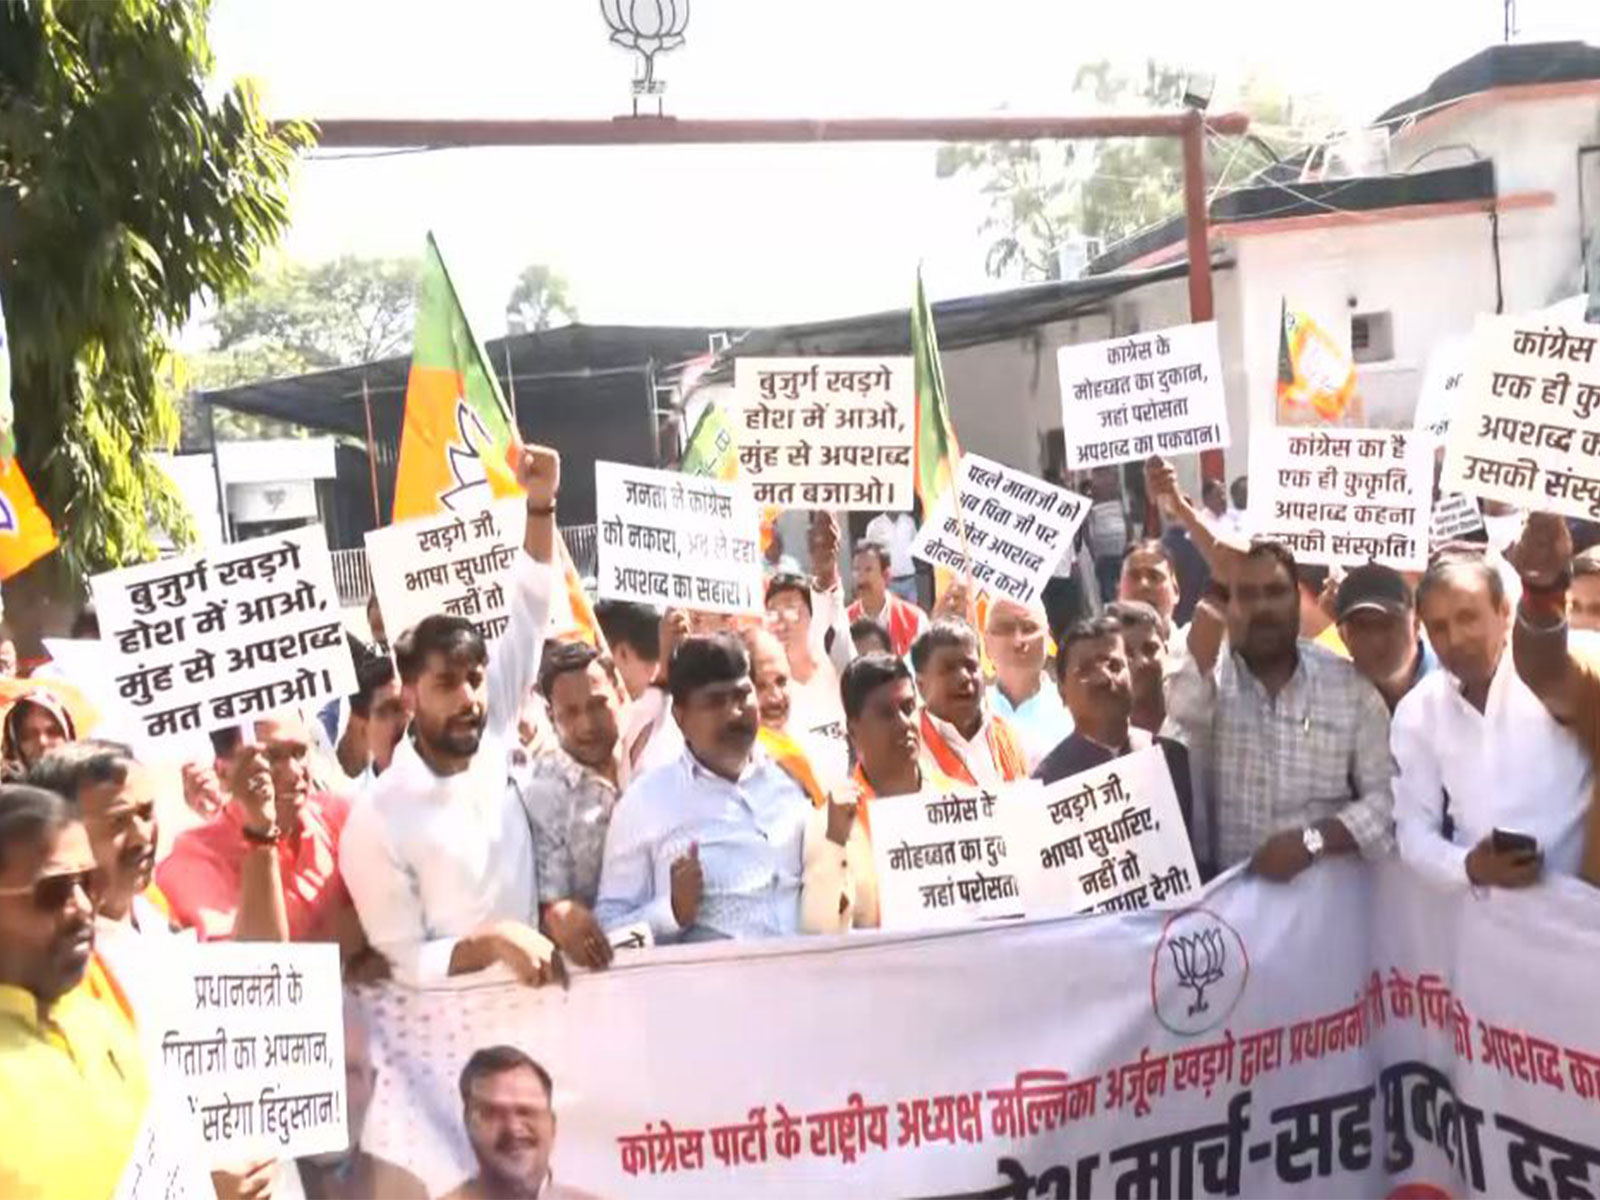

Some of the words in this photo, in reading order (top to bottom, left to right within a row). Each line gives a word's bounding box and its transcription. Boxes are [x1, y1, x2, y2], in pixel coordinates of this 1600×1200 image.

[1155, 335, 1171, 355] के
[1513, 325, 1597, 363] कांग्रेस
[757, 365, 819, 400] बुजुर्ग
[825, 365, 892, 398] खड़गे
[1135, 372, 1153, 390] का
[1158, 363, 1208, 392] दुकान,
[1492, 371, 1535, 400] एक
[1541, 372, 1571, 405] ही
[743, 403, 795, 429] होश
[801, 403, 830, 428] में
[835, 402, 905, 432] आओ,
[1097, 403, 1128, 428] जहां
[1077, 438, 1130, 463] अपशब्द
[1134, 434, 1153, 453] का
[1288, 432, 1352, 457] कांग्रेस
[1356, 439, 1386, 458] का
[1391, 434, 1407, 459] है
[1478, 415, 1576, 452] अपशब्द
[738, 440, 779, 474] मुंह
[786, 440, 812, 466] से
[820, 445, 912, 466] अपशब्द
[1462, 455, 1540, 490] उसकी
[752, 483, 795, 503] मत
[968, 465, 1003, 490] पहले
[1057, 501, 1080, 522] को
[1278, 469, 1312, 488] एक
[1317, 465, 1338, 489] ही
[980, 495, 1012, 525] पिता
[1013, 514, 1035, 536] जी
[1275, 501, 1348, 522] अपशब्द
[1353, 505, 1416, 525] कहना
[416, 516, 466, 552] खड़गे
[602, 514, 623, 547] को
[1252, 529, 1325, 552] सकी
[125, 559, 208, 615] बुजुर्ग
[213, 540, 300, 586] खड़गे
[405, 564, 449, 591] भाषा
[614, 566, 669, 598] अपशब्द
[672, 574, 692, 599] का
[483, 582, 505, 609] तो
[114, 616, 186, 653] होश
[192, 599, 228, 634] में
[236, 579, 327, 625] आओ,
[115, 663, 174, 706] मुंह
[180, 649, 215, 683] से
[226, 621, 342, 672] अपशब्द
[143, 702, 202, 737] मत
[925, 794, 978, 826] कांग्रेस
[1047, 784, 1097, 826] खड़गे
[887, 839, 956, 871] मोहब्बत
[958, 836, 982, 863] का
[1039, 840, 1084, 870] भाषा
[1078, 857, 1118, 895] नहीं
[1121, 850, 1141, 880] तो
[919, 876, 954, 909] जहां
[194, 963, 281, 1010] प्रधानमंत्री
[286, 963, 303, 1006] के
[231, 1036, 256, 1070] का
[616, 1119, 705, 1178] कांग्रेस
[709, 1106, 768, 1168] पार्टी
[773, 1103, 802, 1161] के
[805, 1091, 889, 1165] राष्ट्रीय
[897, 1091, 983, 1147] अध्यक्ष
[985, 1069, 1101, 1140] मल्लिका
[1172, 1028, 1235, 1098] खड़गे
[1238, 1029, 1283, 1087] द्वारा
[1387, 966, 1414, 1020] के
[1477, 1019, 1565, 1091] अपशब्द
[201, 1092, 254, 1141] सहेगा
